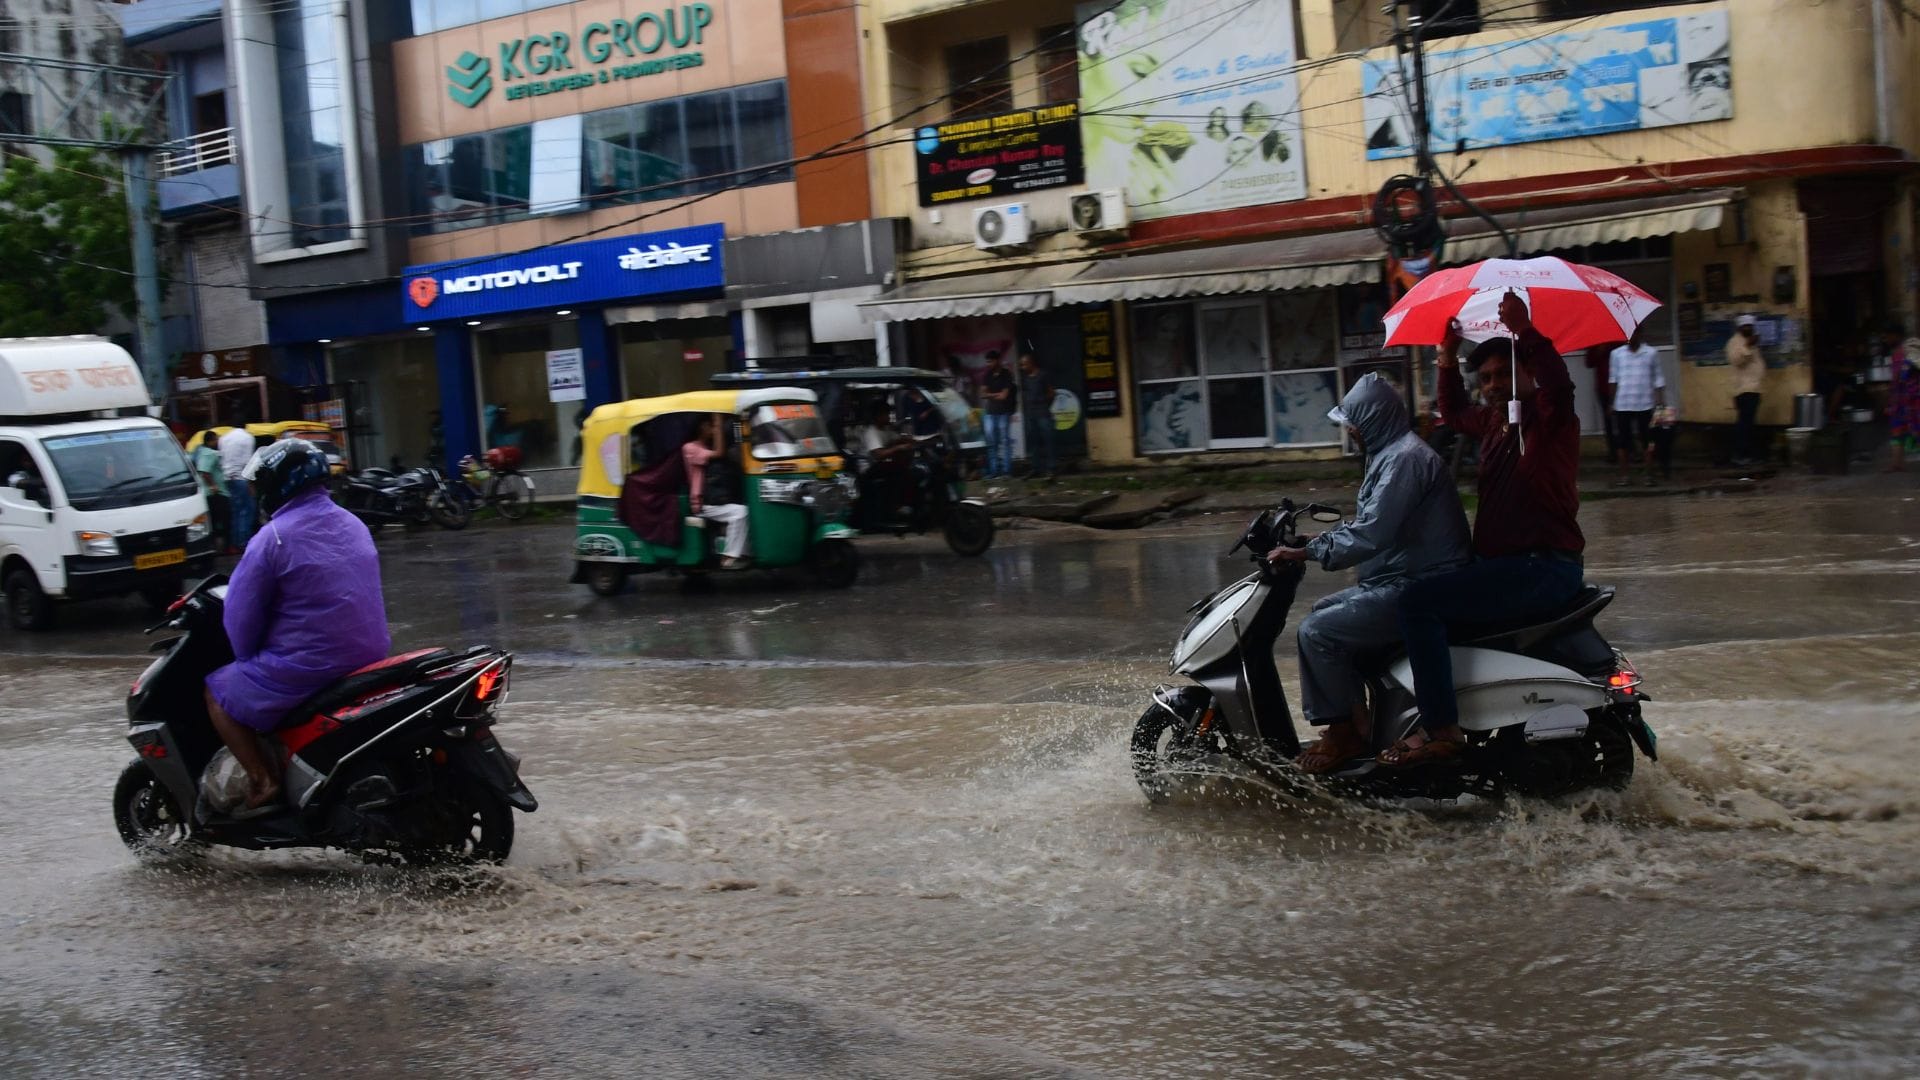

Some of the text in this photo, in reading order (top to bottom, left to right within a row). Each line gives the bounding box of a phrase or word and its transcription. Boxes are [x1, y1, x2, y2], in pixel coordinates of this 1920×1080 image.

[499, 2, 712, 81] KGR GROUP
[505, 52, 704, 100] DEVELOPERS & PROMOTERS
[1036, 103, 1078, 126] CLINIC
[1001, 148, 1039, 163] Kumar
[618, 242, 712, 270] मोटोवोल्ट
[443, 261, 583, 295] MOTOVOLT
[20, 361, 137, 394] डाक पार्सल
